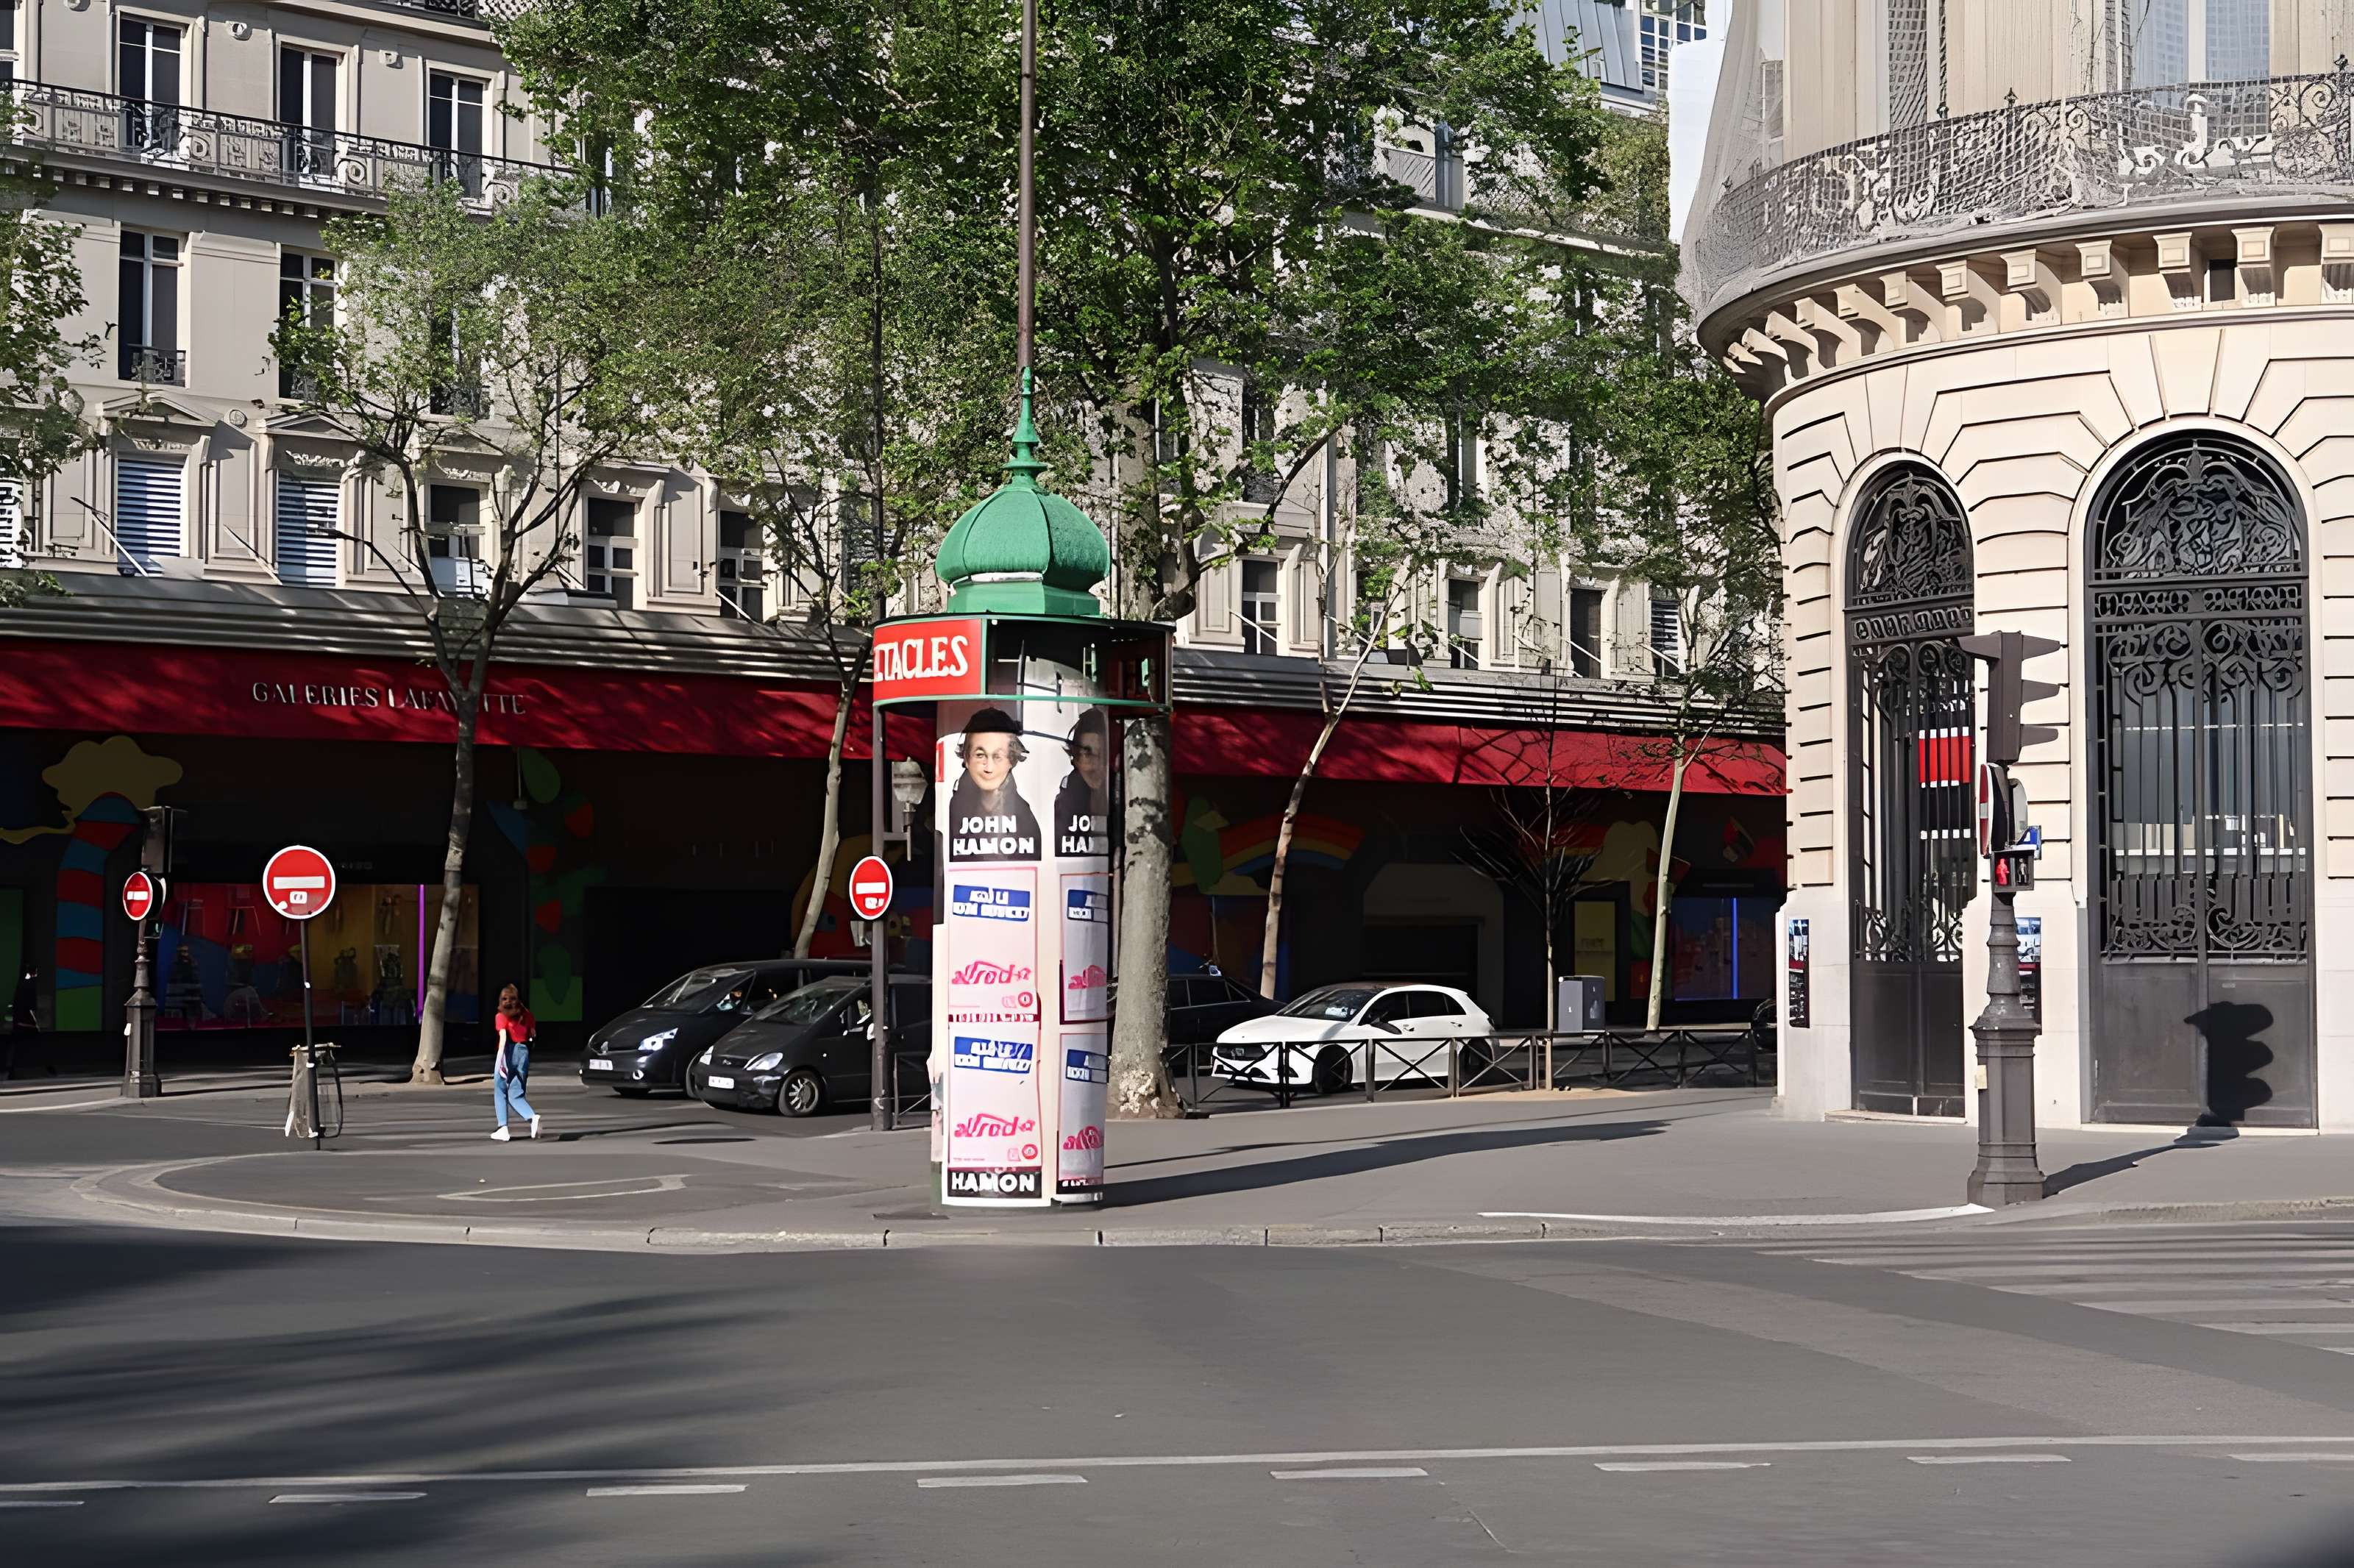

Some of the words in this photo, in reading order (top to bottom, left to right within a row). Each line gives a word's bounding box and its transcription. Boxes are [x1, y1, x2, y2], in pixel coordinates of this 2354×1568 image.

[252, 682, 379, 708] GALERIES
[388, 687, 527, 716] LAFAYTTE
[959, 815, 1017, 834] JOHN
[953, 837, 1034, 855] HAMON
[951, 1172, 1035, 1192] HAMON
